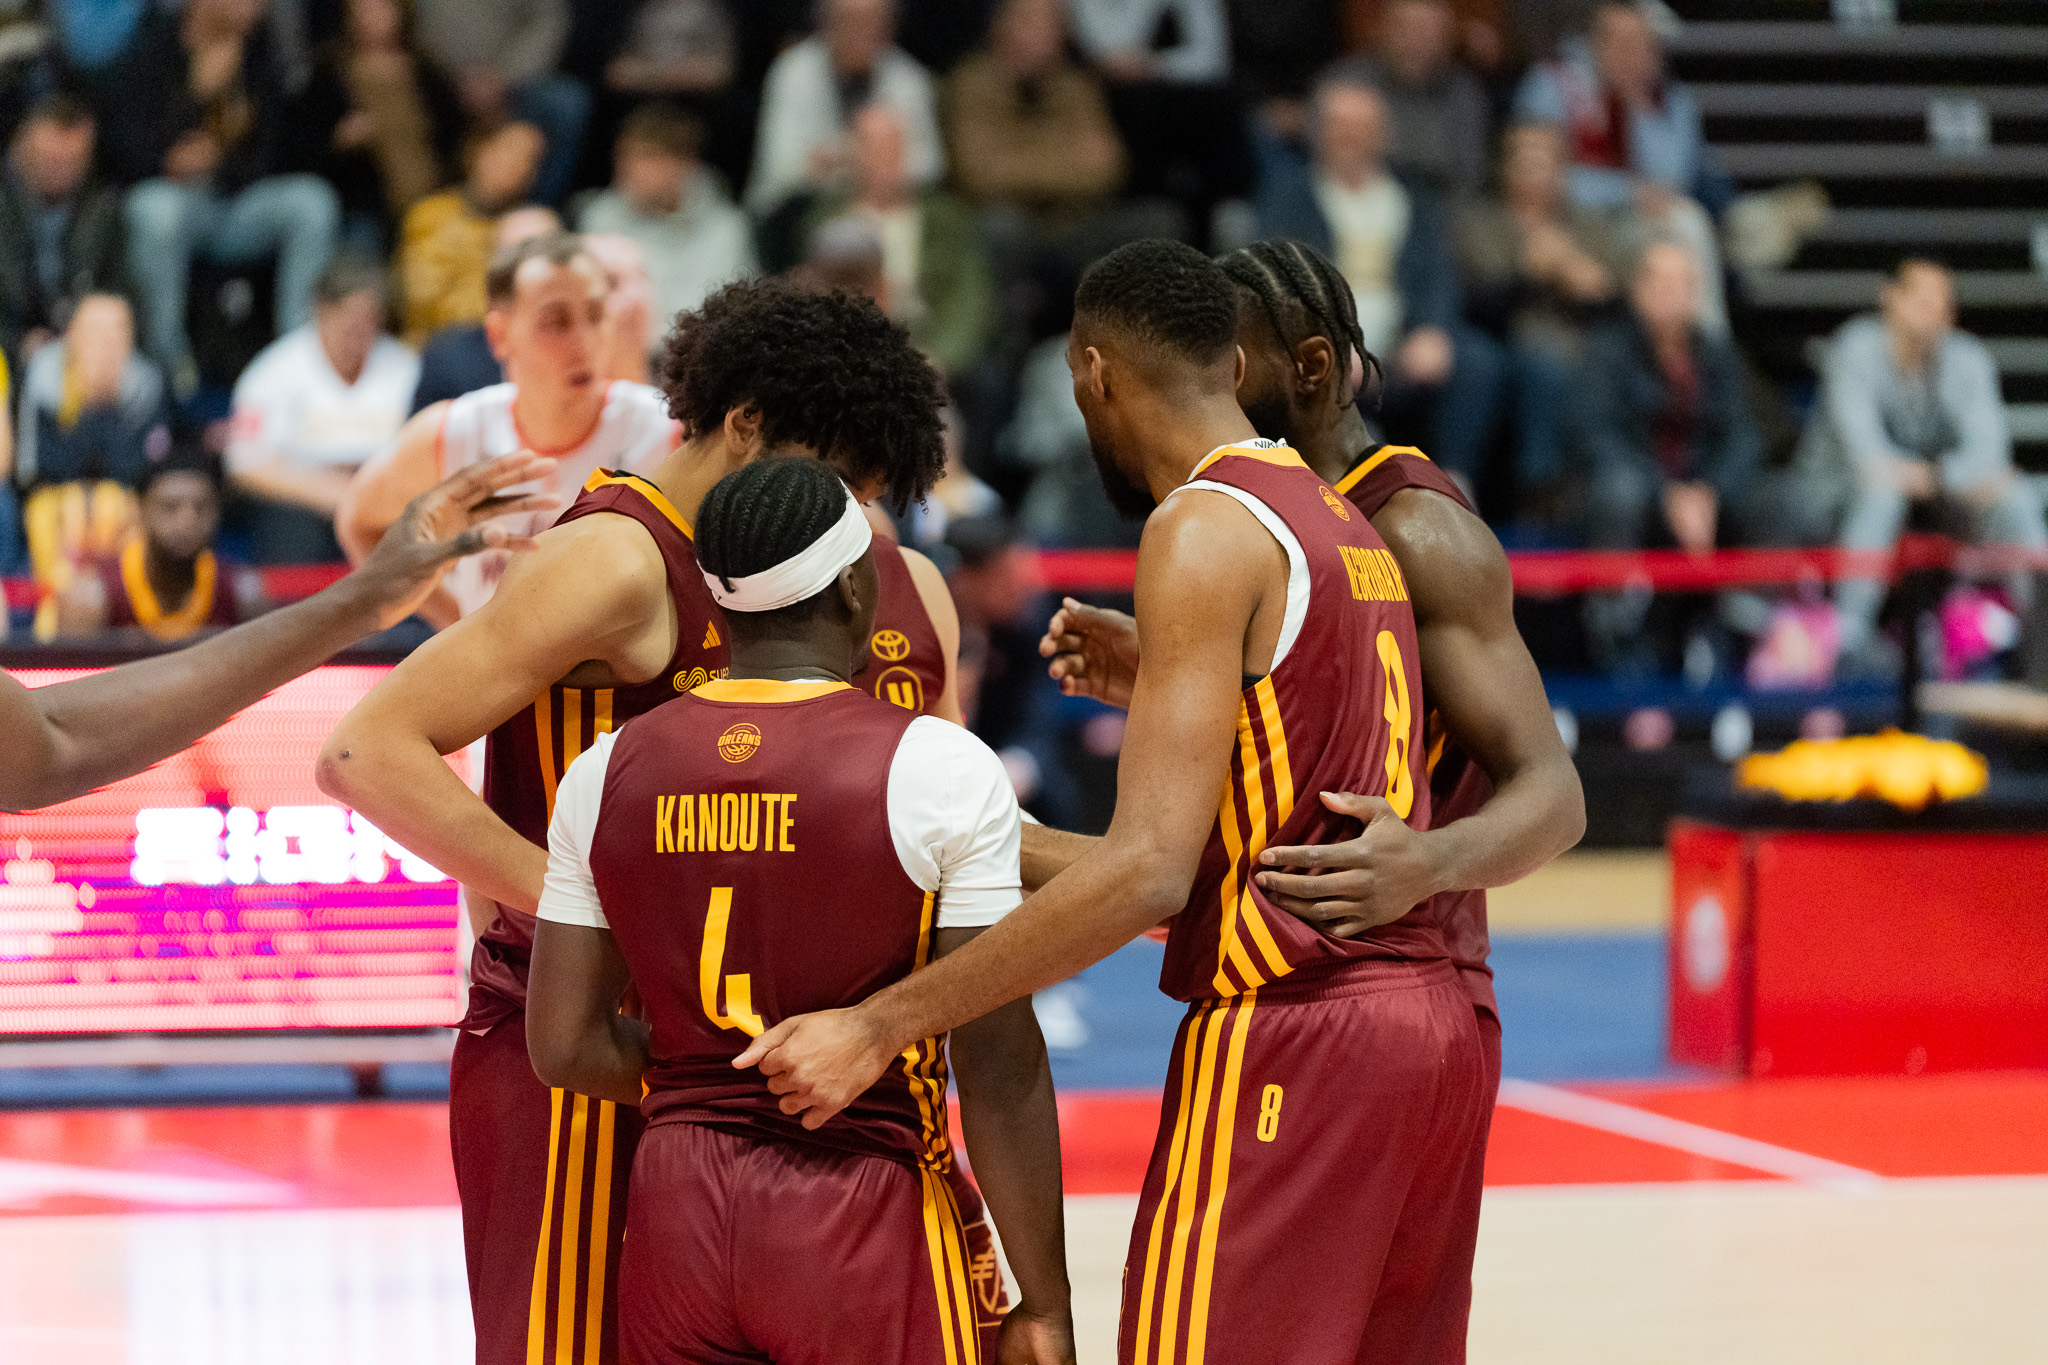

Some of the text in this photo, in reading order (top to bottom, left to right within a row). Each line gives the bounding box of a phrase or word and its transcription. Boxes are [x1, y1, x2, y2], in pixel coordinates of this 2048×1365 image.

[1336, 545, 1408, 601] NEGROBAR
[717, 732, 762, 747] ORLEANS
[1376, 630, 1413, 819] 8
[656, 793, 797, 853] KANOUTE
[700, 887, 765, 1038] 4
[1257, 1084, 1283, 1142] 8
